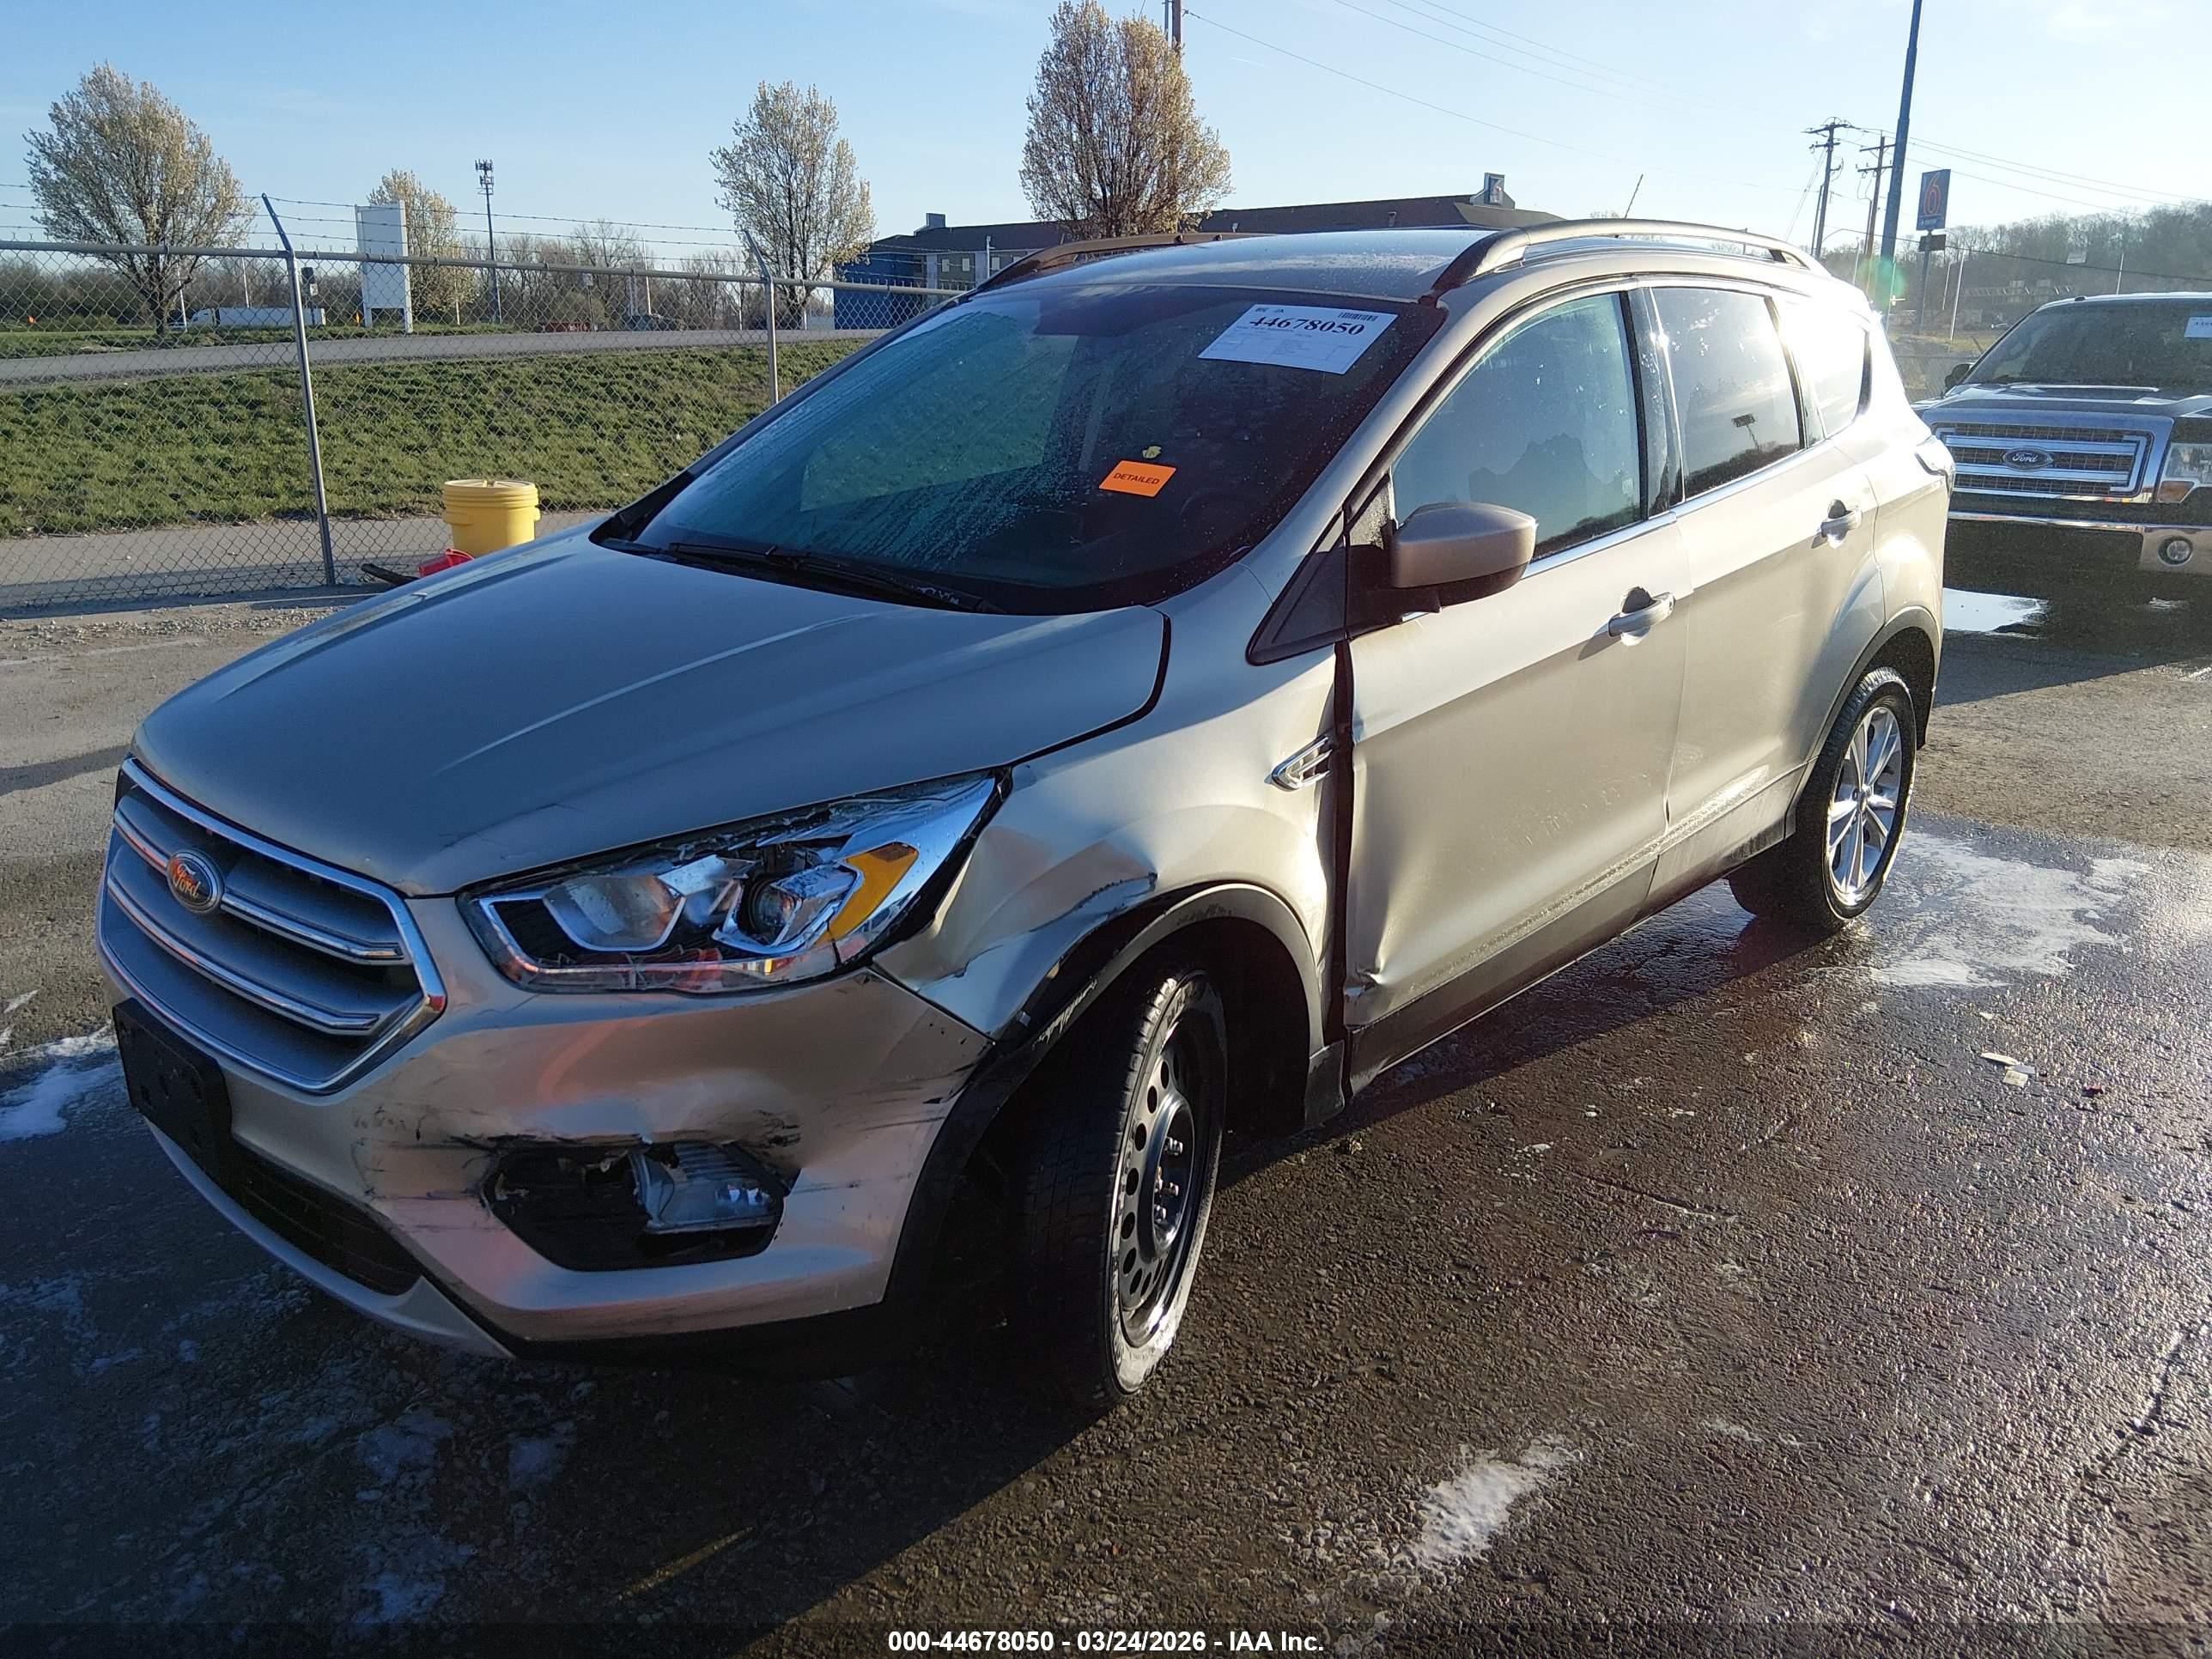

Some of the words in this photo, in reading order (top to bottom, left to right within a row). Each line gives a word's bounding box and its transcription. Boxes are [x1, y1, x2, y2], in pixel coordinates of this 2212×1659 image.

[1923, 172, 1942, 216] 6
[1249, 316, 1365, 336] 44678050
[2012, 452, 2039, 463] Ford
[1113, 472, 1160, 485] DETAILED
[173, 863, 202, 899] Ford
